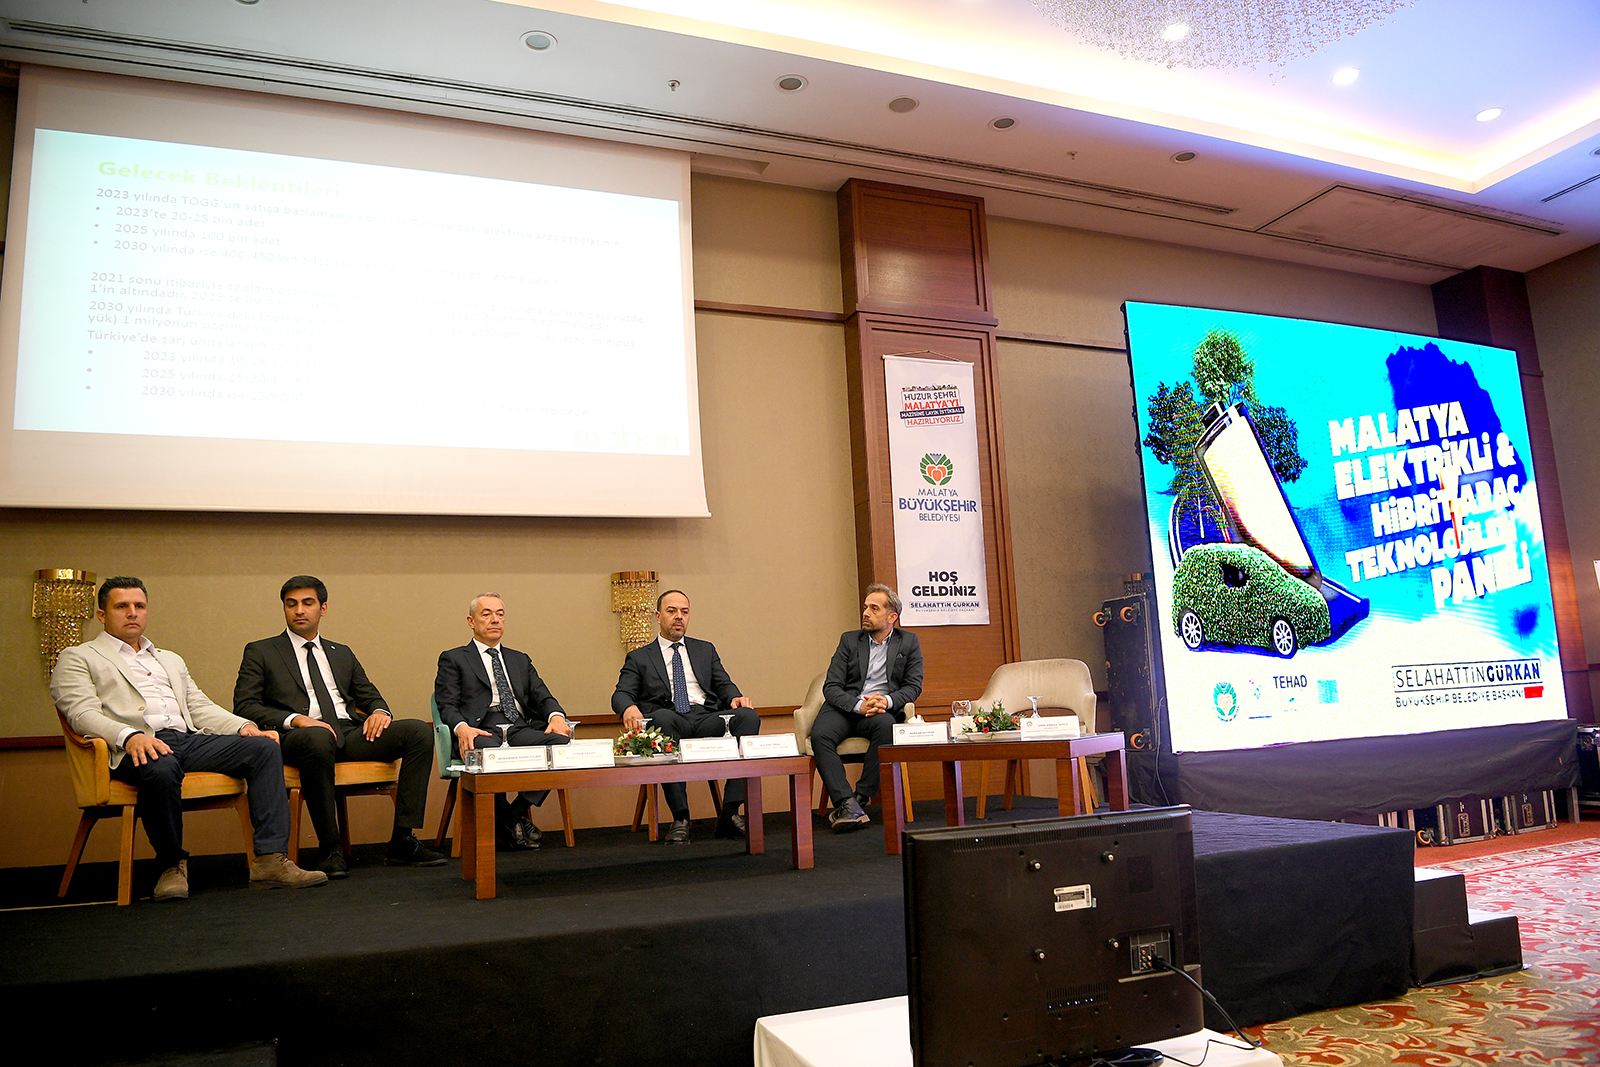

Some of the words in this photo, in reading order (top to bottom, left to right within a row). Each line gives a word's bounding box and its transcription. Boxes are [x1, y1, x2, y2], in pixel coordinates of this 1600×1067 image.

[98, 161, 196, 184] Gelecek
[205, 171, 340, 198] Beklentileri
[96, 187, 129, 200] 2023
[133, 192, 178, 204] yılında
[115, 206, 167, 220] 2023'te
[171, 211, 209, 223] 20-25
[213, 215, 233, 226] bin
[237, 217, 267, 229] adet
[114, 223, 148, 235] 2025
[151, 227, 196, 240] yılında
[200, 231, 225, 241] 100
[228, 233, 248, 243] bin
[252, 235, 281, 246] adet
[113, 239, 148, 251] 2030
[151, 243, 195, 256] yılında
[199, 246, 217, 257] ise
[91, 271, 125, 283] 2021
[128, 276, 162, 286] sonu
[89, 300, 124, 312] 2030
[127, 303, 172, 315] yılında
[88, 313, 118, 326] yük)
[134, 316, 198, 328] milyonun
[161, 335, 186, 347] şarj
[143, 350, 177, 362] 2023
[142, 368, 176, 380] 2025
[141, 385, 176, 397] 2030
[904, 392, 932, 401] HUZUR
[906, 415, 961, 426] HAZIRLIYORUZ
[1328, 401, 1470, 457] MALATYA
[1496, 432, 1517, 468] &
[917, 488, 959, 498] MALATYA
[928, 571, 959, 585] HOŞ
[1272, 675, 1308, 689] TEHAD
